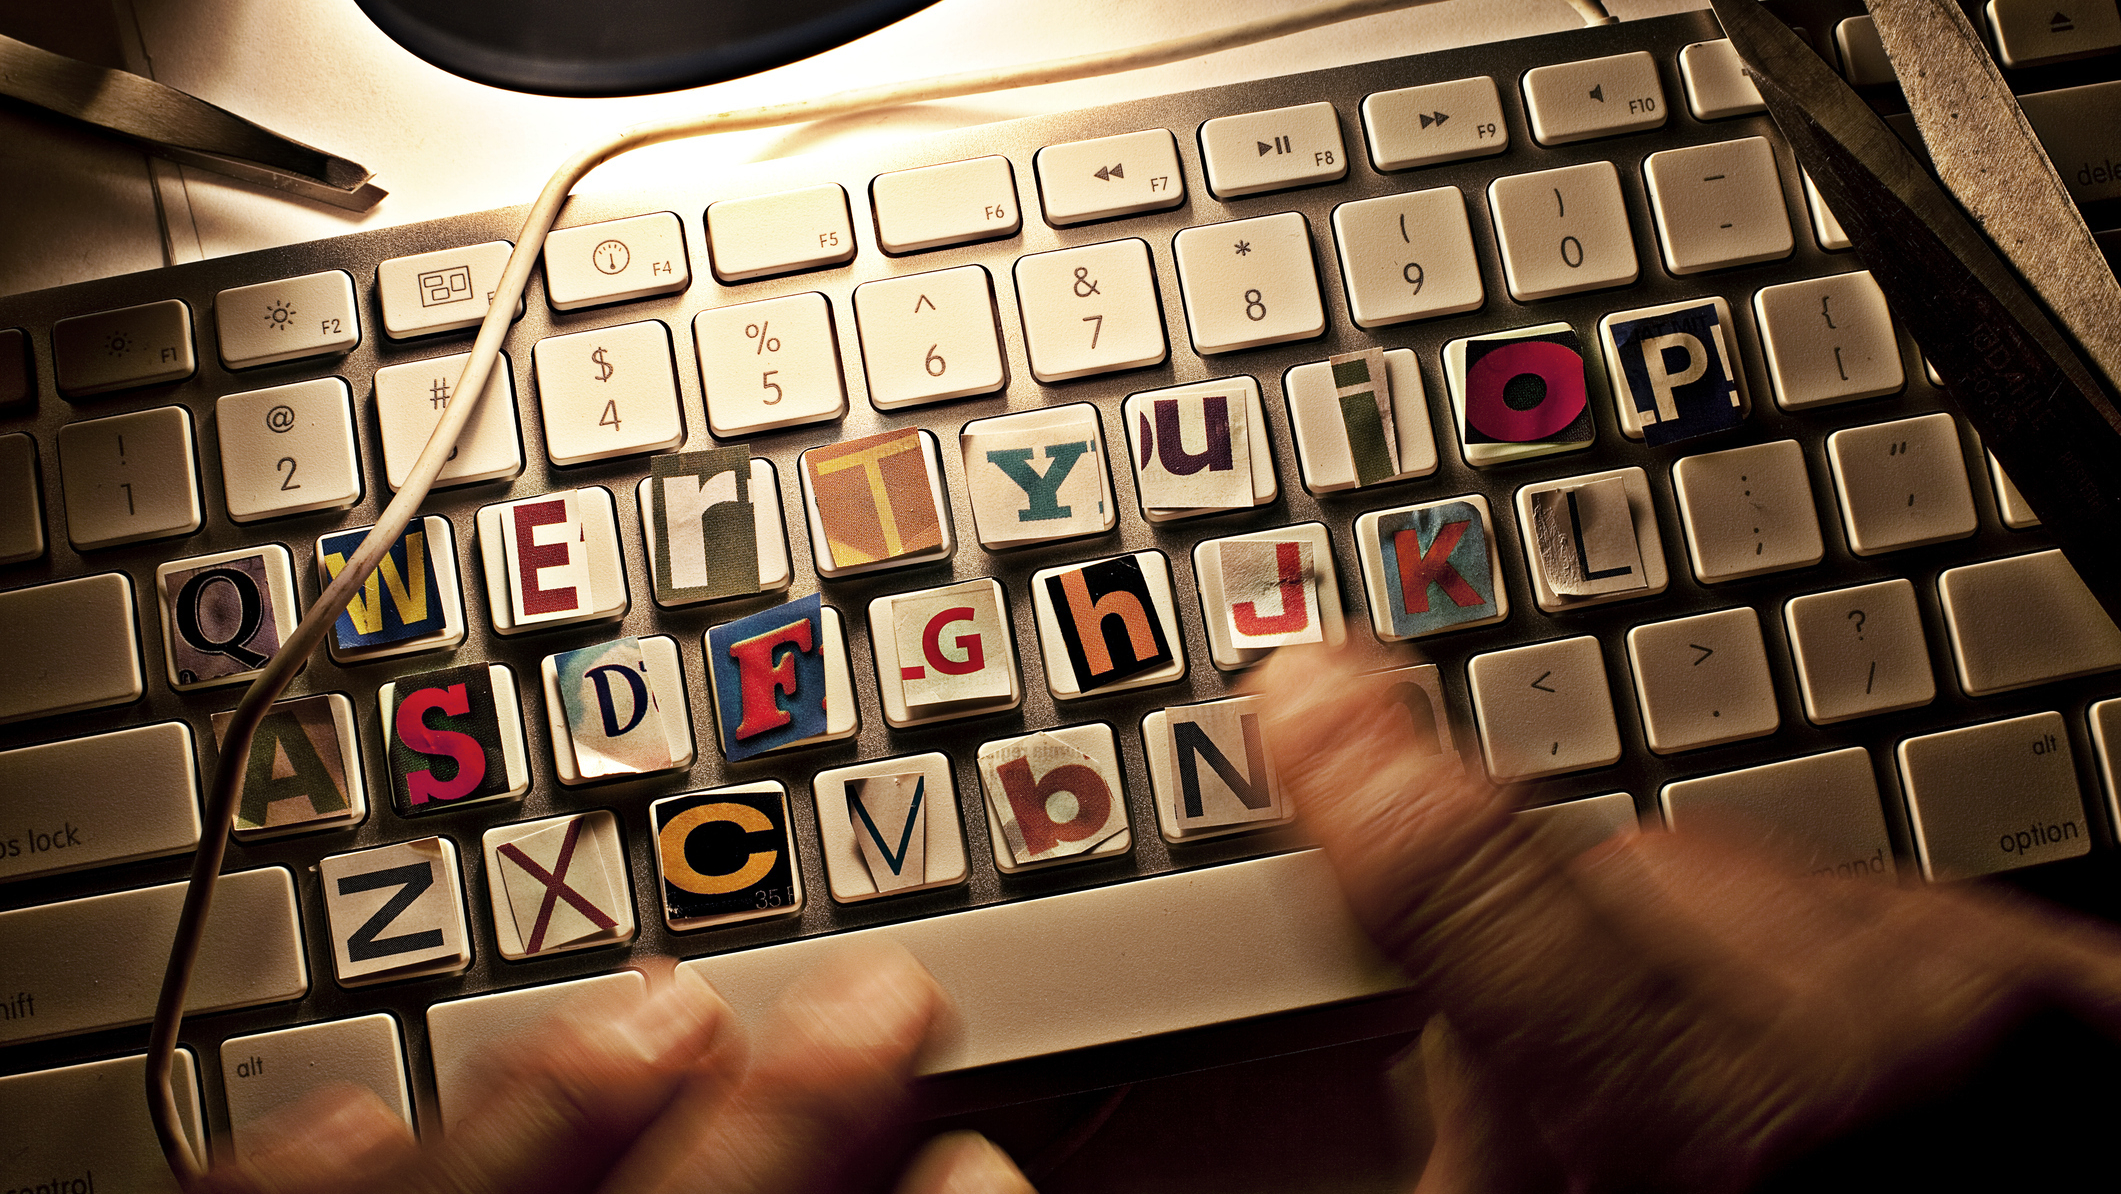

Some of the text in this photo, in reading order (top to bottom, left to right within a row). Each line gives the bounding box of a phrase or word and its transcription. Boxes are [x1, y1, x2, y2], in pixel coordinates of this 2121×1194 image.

[1628, 98, 1656, 115] F10
[1477, 122, 1497, 139] F9
[1314, 151, 1335, 166] F8
[1150, 177, 1169, 192] F7
[984, 205, 1006, 220] F6
[1553, 187, 1564, 218] )
[819, 232, 839, 248] F5
[1400, 213, 1411, 244] (
[652, 261, 673, 277] F4
[1561, 236, 1584, 268] 0
[1073, 266, 1102, 298] &
[1403, 262, 1425, 296] 9
[914, 294, 937, 314] ^
[1245, 289, 1267, 322] 8
[1821, 295, 1837, 330] {
[321, 319, 343, 335] F2
[744, 320, 781, 356] %
[1082, 314, 1104, 350] 7
[160, 347, 178, 362] F1
[590, 347, 615, 383] $
[925, 343, 947, 378] 6
[1834, 346, 1850, 381] [
[430, 377, 450, 410] #
[762, 370, 784, 406] 5
[265, 405, 296, 434] @
[598, 400, 622, 432] 4
[1330, 358, 1400, 487] i
[117, 434, 127, 466] !
[276, 457, 301, 491] 2
[987, 440, 1088, 522] Y
[1740, 474, 1751, 497] :
[120, 482, 135, 515] 1
[816, 433, 922, 558] T
[662, 469, 738, 590] r
[1566, 491, 1633, 582] L
[1753, 527, 1764, 556] ;
[513, 498, 580, 617] E
[1391, 518, 1486, 615] K
[324, 530, 429, 636] W
[1230, 540, 1309, 637] J
[176, 567, 270, 670] Q
[1058, 566, 1161, 677] h
[1847, 609, 1868, 642] ?
[1689, 643, 1714, 666] >
[728, 617, 815, 742] F
[1530, 670, 1556, 694] <
[1865, 661, 1877, 695] /
[396, 682, 487, 806] S
[2032, 734, 2058, 756] alt
[235, 709, 350, 829] A
[1173, 712, 1272, 819] N
[996, 755, 1112, 857] b
[28, 822, 82, 854] lock
[845, 775, 925, 877] V
[1999, 821, 2079, 856] option
[658, 802, 778, 895] C
[497, 816, 620, 956] X
[336, 860, 445, 963] Z
[236, 1056, 265, 1079] alt
